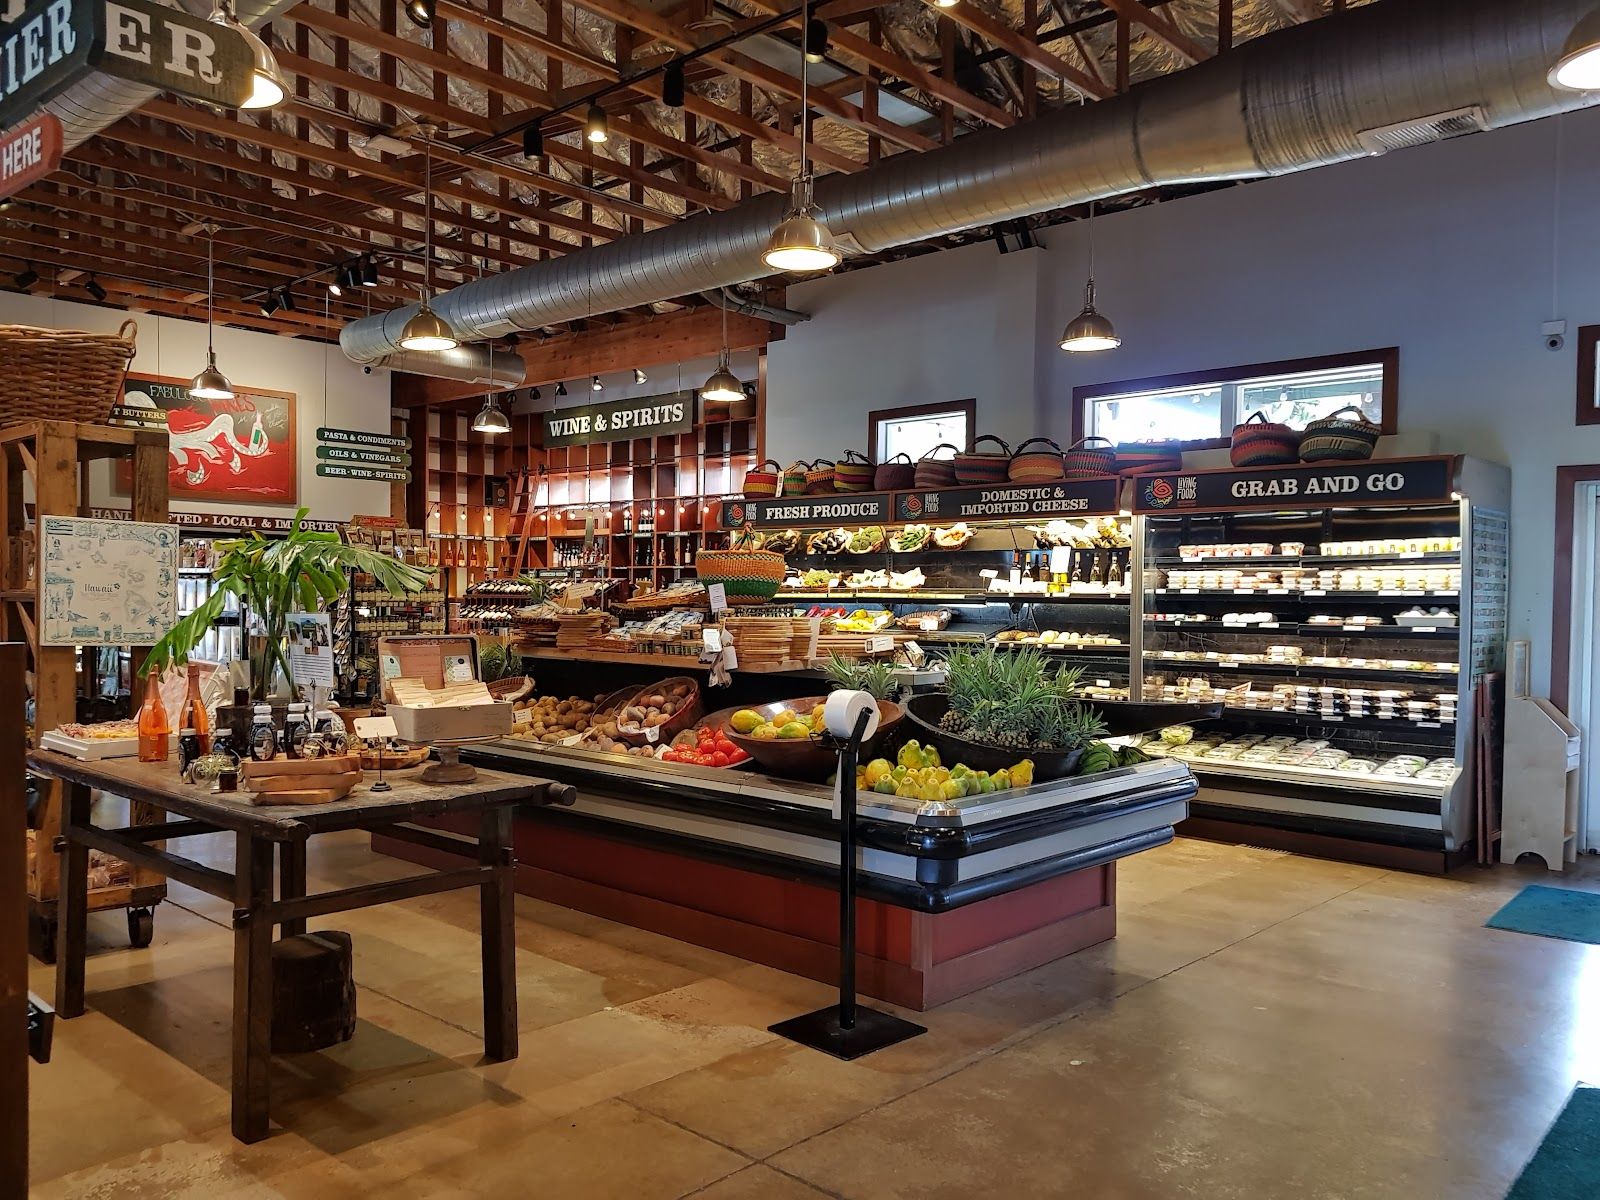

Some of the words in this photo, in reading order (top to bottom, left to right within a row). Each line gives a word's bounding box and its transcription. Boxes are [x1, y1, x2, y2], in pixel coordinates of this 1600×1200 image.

[0, 0, 77, 99] IER
[2, 127, 42, 181] HERE
[122, 409, 167, 421] BUTTERS
[550, 416, 591, 437] WINE
[594, 414, 608, 432] &
[611, 403, 684, 430] SPIRITS
[324, 431, 348, 440] PASTA
[357, 435, 406, 447] CONDIMENTS
[329, 450, 349, 458] OILS
[360, 453, 401, 463] VINEGARS
[981, 489, 1050, 501] DOMESTIC
[1053, 487, 1065, 498] &
[1231, 480, 1298, 498] GRAB
[1304, 476, 1360, 494] AND
[1366, 472, 1405, 491] GO
[765, 506, 811, 520] FRESH
[813, 502, 879, 518] PRODUCE
[960, 500, 1030, 516] IMPORTED
[1032, 498, 1089, 512] CHEESE
[212, 514, 256, 528] LOCAL
[261, 516, 272, 528] &
[274, 519, 341, 532] IMORTE
[84, 583, 113, 593] Hawaii
